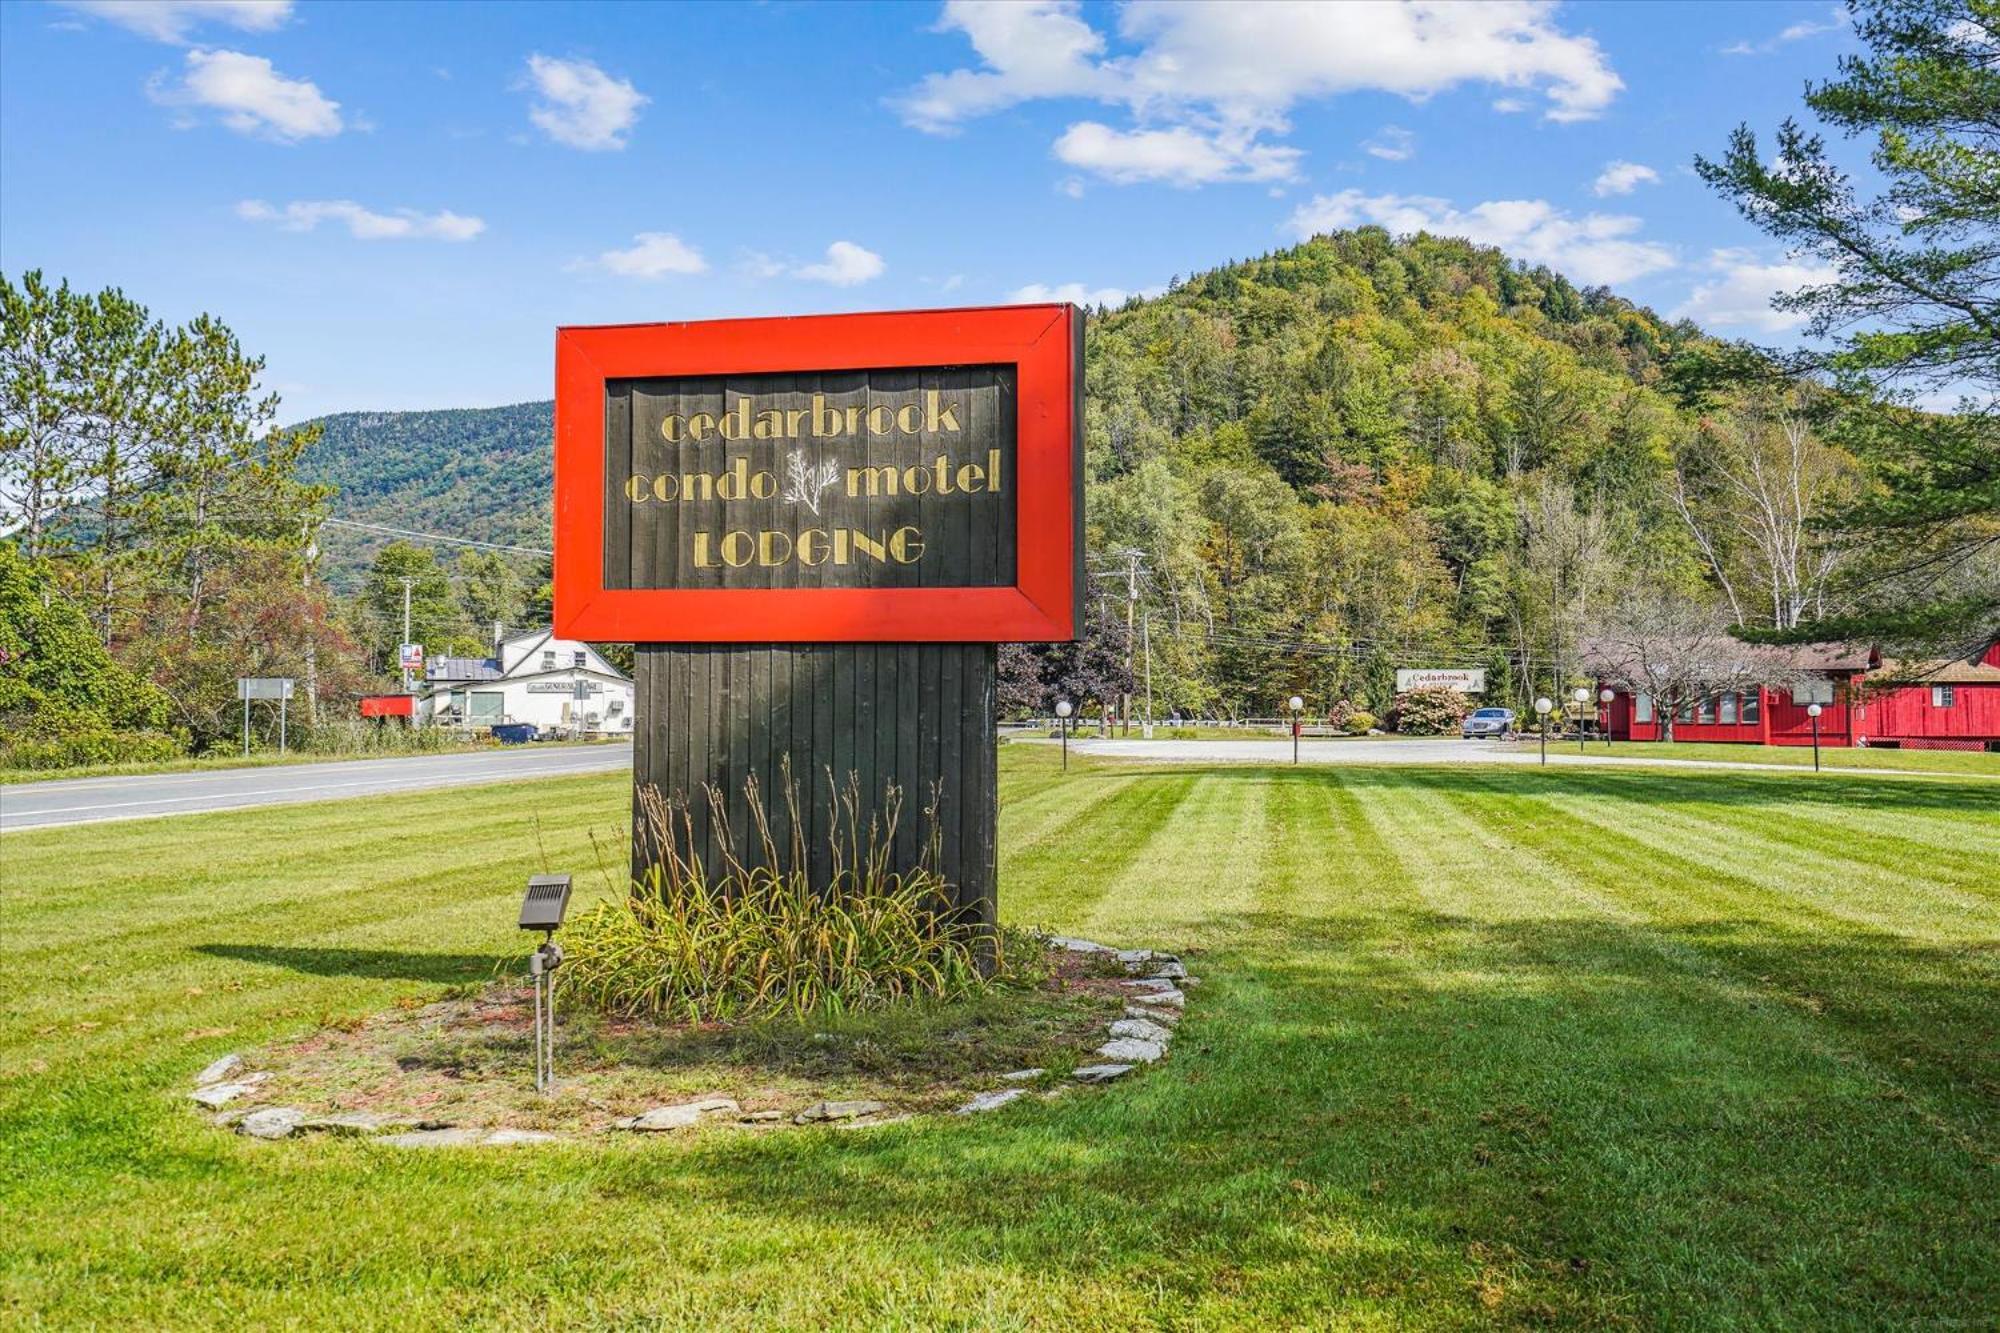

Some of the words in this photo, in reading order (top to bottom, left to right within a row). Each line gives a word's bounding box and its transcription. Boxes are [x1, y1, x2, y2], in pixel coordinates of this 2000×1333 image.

[661, 390, 961, 442] cedarbrook
[625, 457, 778, 502] condo
[847, 448, 1001, 497] motel
[694, 525, 926, 569] LODGING
[1413, 673, 1469, 681] Cedarbrook
